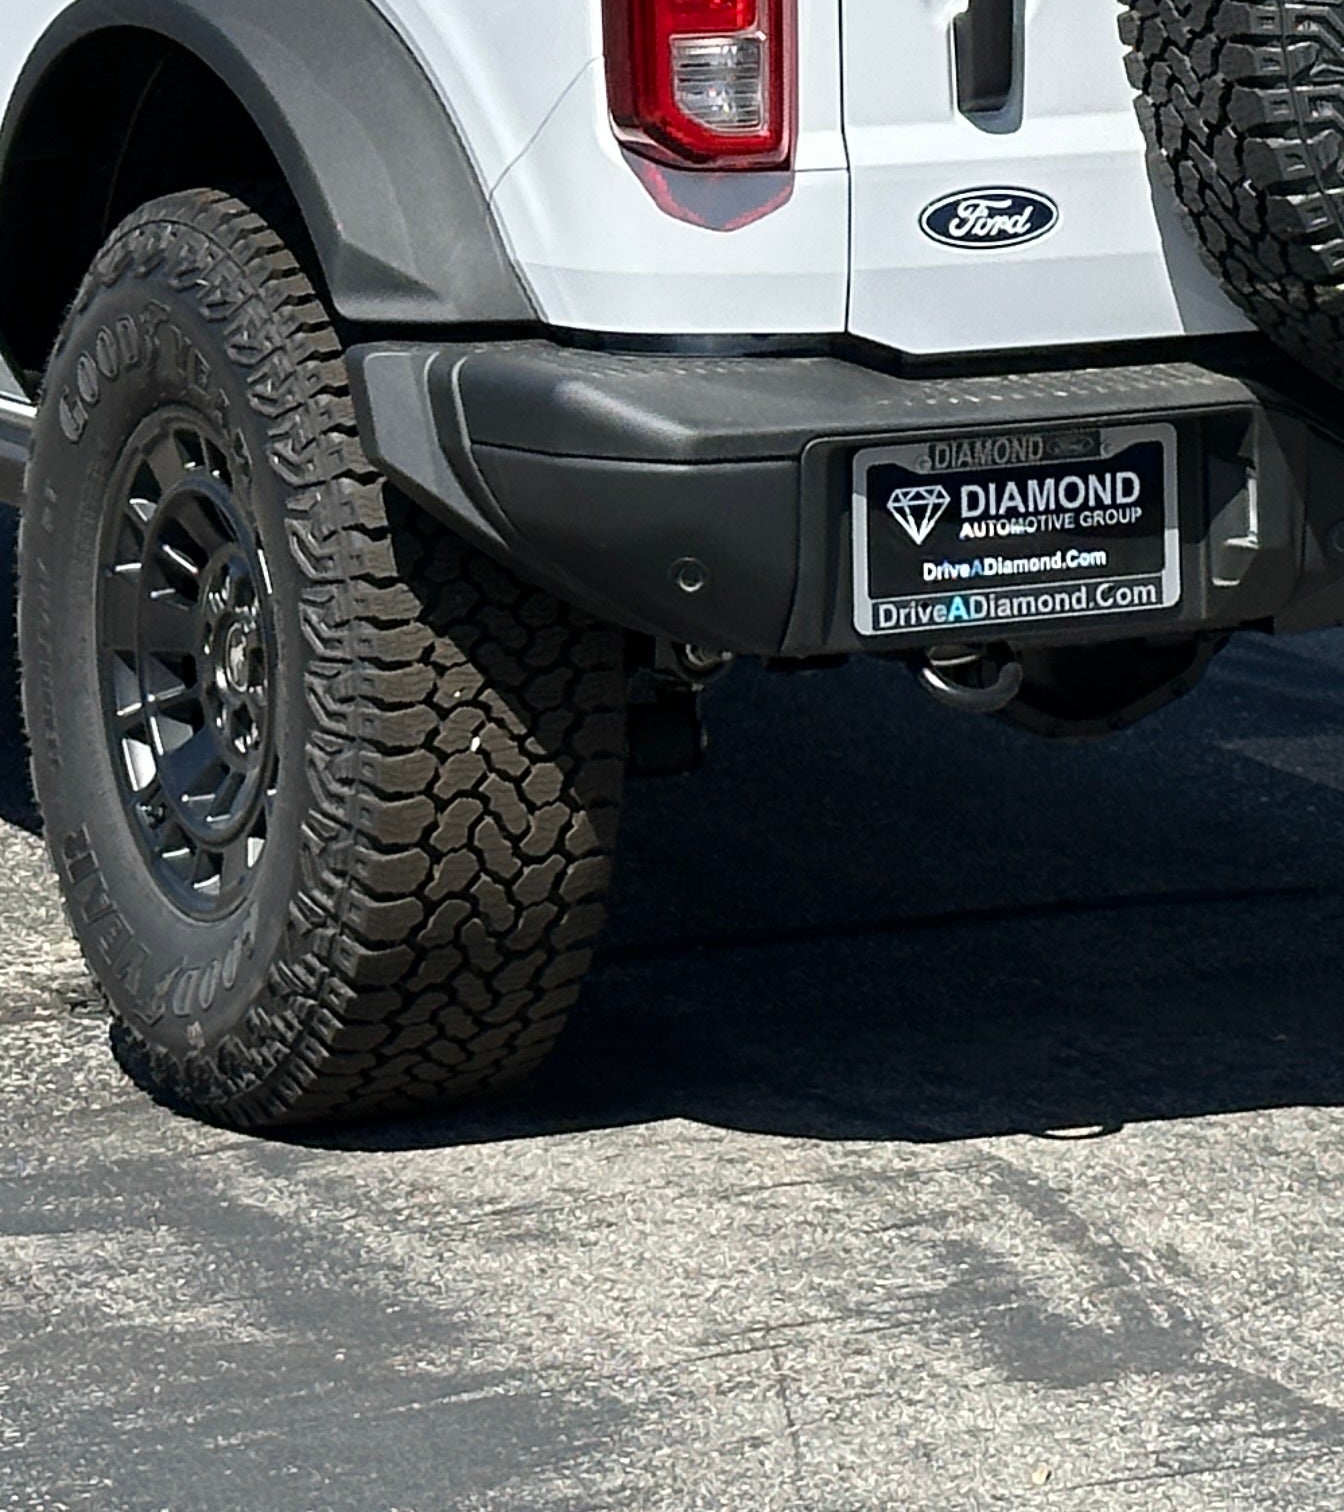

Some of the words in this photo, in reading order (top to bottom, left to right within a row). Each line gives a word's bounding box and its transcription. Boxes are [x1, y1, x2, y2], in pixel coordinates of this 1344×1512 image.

[934, 435, 1044, 470] DIAMOND
[960, 471, 1141, 519] DIAMOND
[959, 512, 1075, 540] AUTOMOTIVE
[1079, 506, 1143, 528] GROUP
[922, 548, 1108, 582] DriveADiamond.Com
[878, 583, 1158, 629] DriveADiamond.Com
